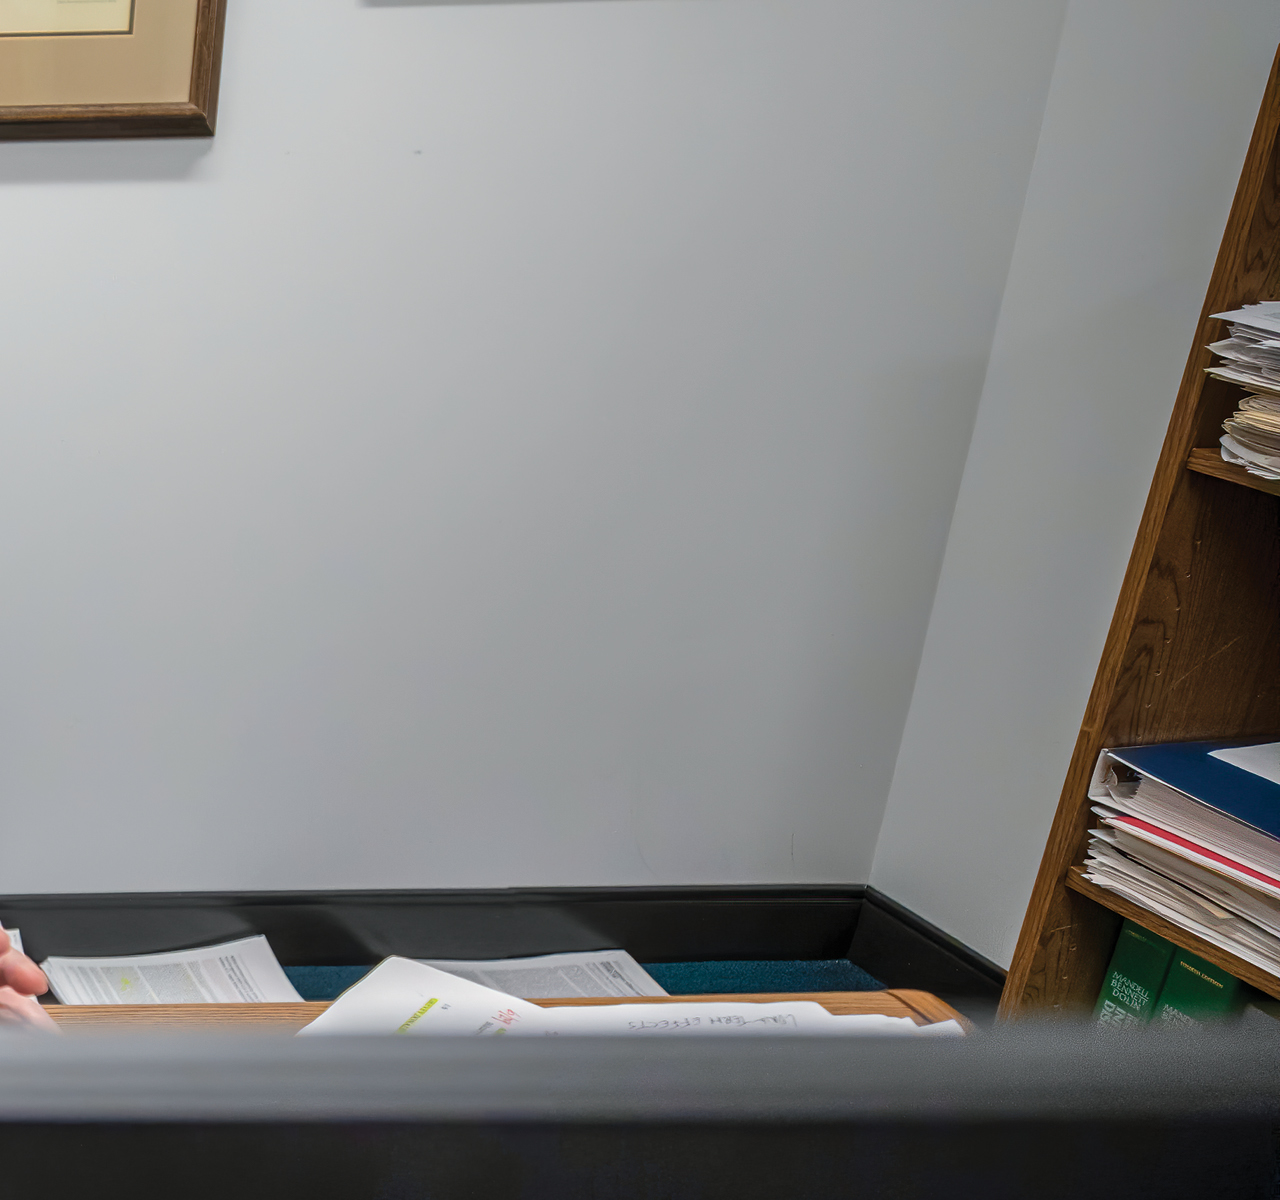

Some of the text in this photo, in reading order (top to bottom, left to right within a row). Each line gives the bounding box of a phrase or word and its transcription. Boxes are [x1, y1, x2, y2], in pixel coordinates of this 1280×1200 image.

[1110, 979, 1150, 1006] BENNETT
[1112, 971, 1150, 1001] MANDELL
[1111, 988, 1143, 1011] DOLIN
[627, 1015, 701, 1032] EFFECTS
